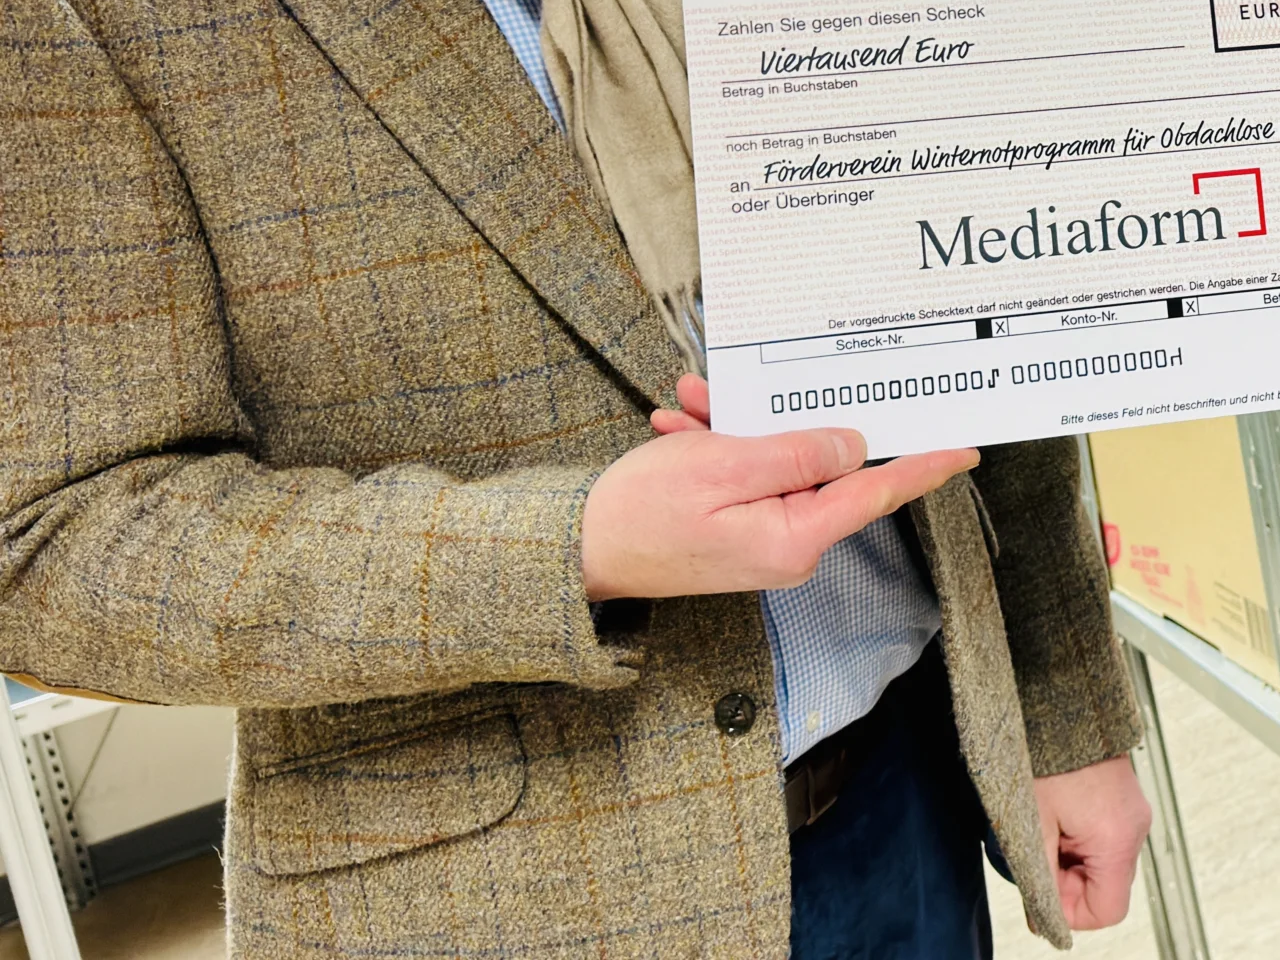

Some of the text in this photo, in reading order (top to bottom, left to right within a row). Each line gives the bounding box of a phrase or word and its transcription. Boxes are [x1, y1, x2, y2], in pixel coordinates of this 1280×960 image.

[718, 4, 985, 36] Zahlen Sie gegen diesen Scheck
[1239, 3, 1280, 20] EUR
[760, 35, 974, 76] Viertausend Euro
[722, 78, 858, 99] Betrag in Buchstaben
[726, 128, 897, 153] noch Betrag in Buchstaben
[763, 149, 902, 184] Förderverein
[911, 138, 1116, 172] Winternotprogramm
[1122, 128, 1155, 157] für
[1161, 117, 1274, 149] Obdachlose
[730, 181, 750, 193] an
[731, 189, 874, 213] oder Überbringer
[917, 199, 1227, 271] Mediaform
[828, 319, 847, 330] Der
[850, 311, 916, 329] vorgedruckte
[919, 305, 974, 320] Schecktext
[976, 303, 997, 314] darf
[999, 300, 1023, 312] nicht
[1026, 294, 1069, 311] geändert
[1072, 292, 1094, 304] oder
[1096, 287, 1147, 304] gestrichen
[1149, 283, 1186, 296] werden.
[1189, 278, 1205, 291] Die
[1208, 274, 1243, 291] Angabe
[1246, 274, 1268, 286] einer
[836, 334, 906, 352] Scheck-Nr.
[995, 320, 1006, 335] X
[1060, 310, 1118, 327] Konto-Nr.
[1185, 300, 1196, 313] X
[1061, 414, 1084, 425] Bitte
[1087, 410, 1119, 422] dieses
[1122, 406, 1143, 418] Feld
[1146, 404, 1170, 415] nicht
[1173, 396, 1227, 412] beschriften
[1229, 394, 1248, 406] und
[1251, 391, 1275, 402] nicht
